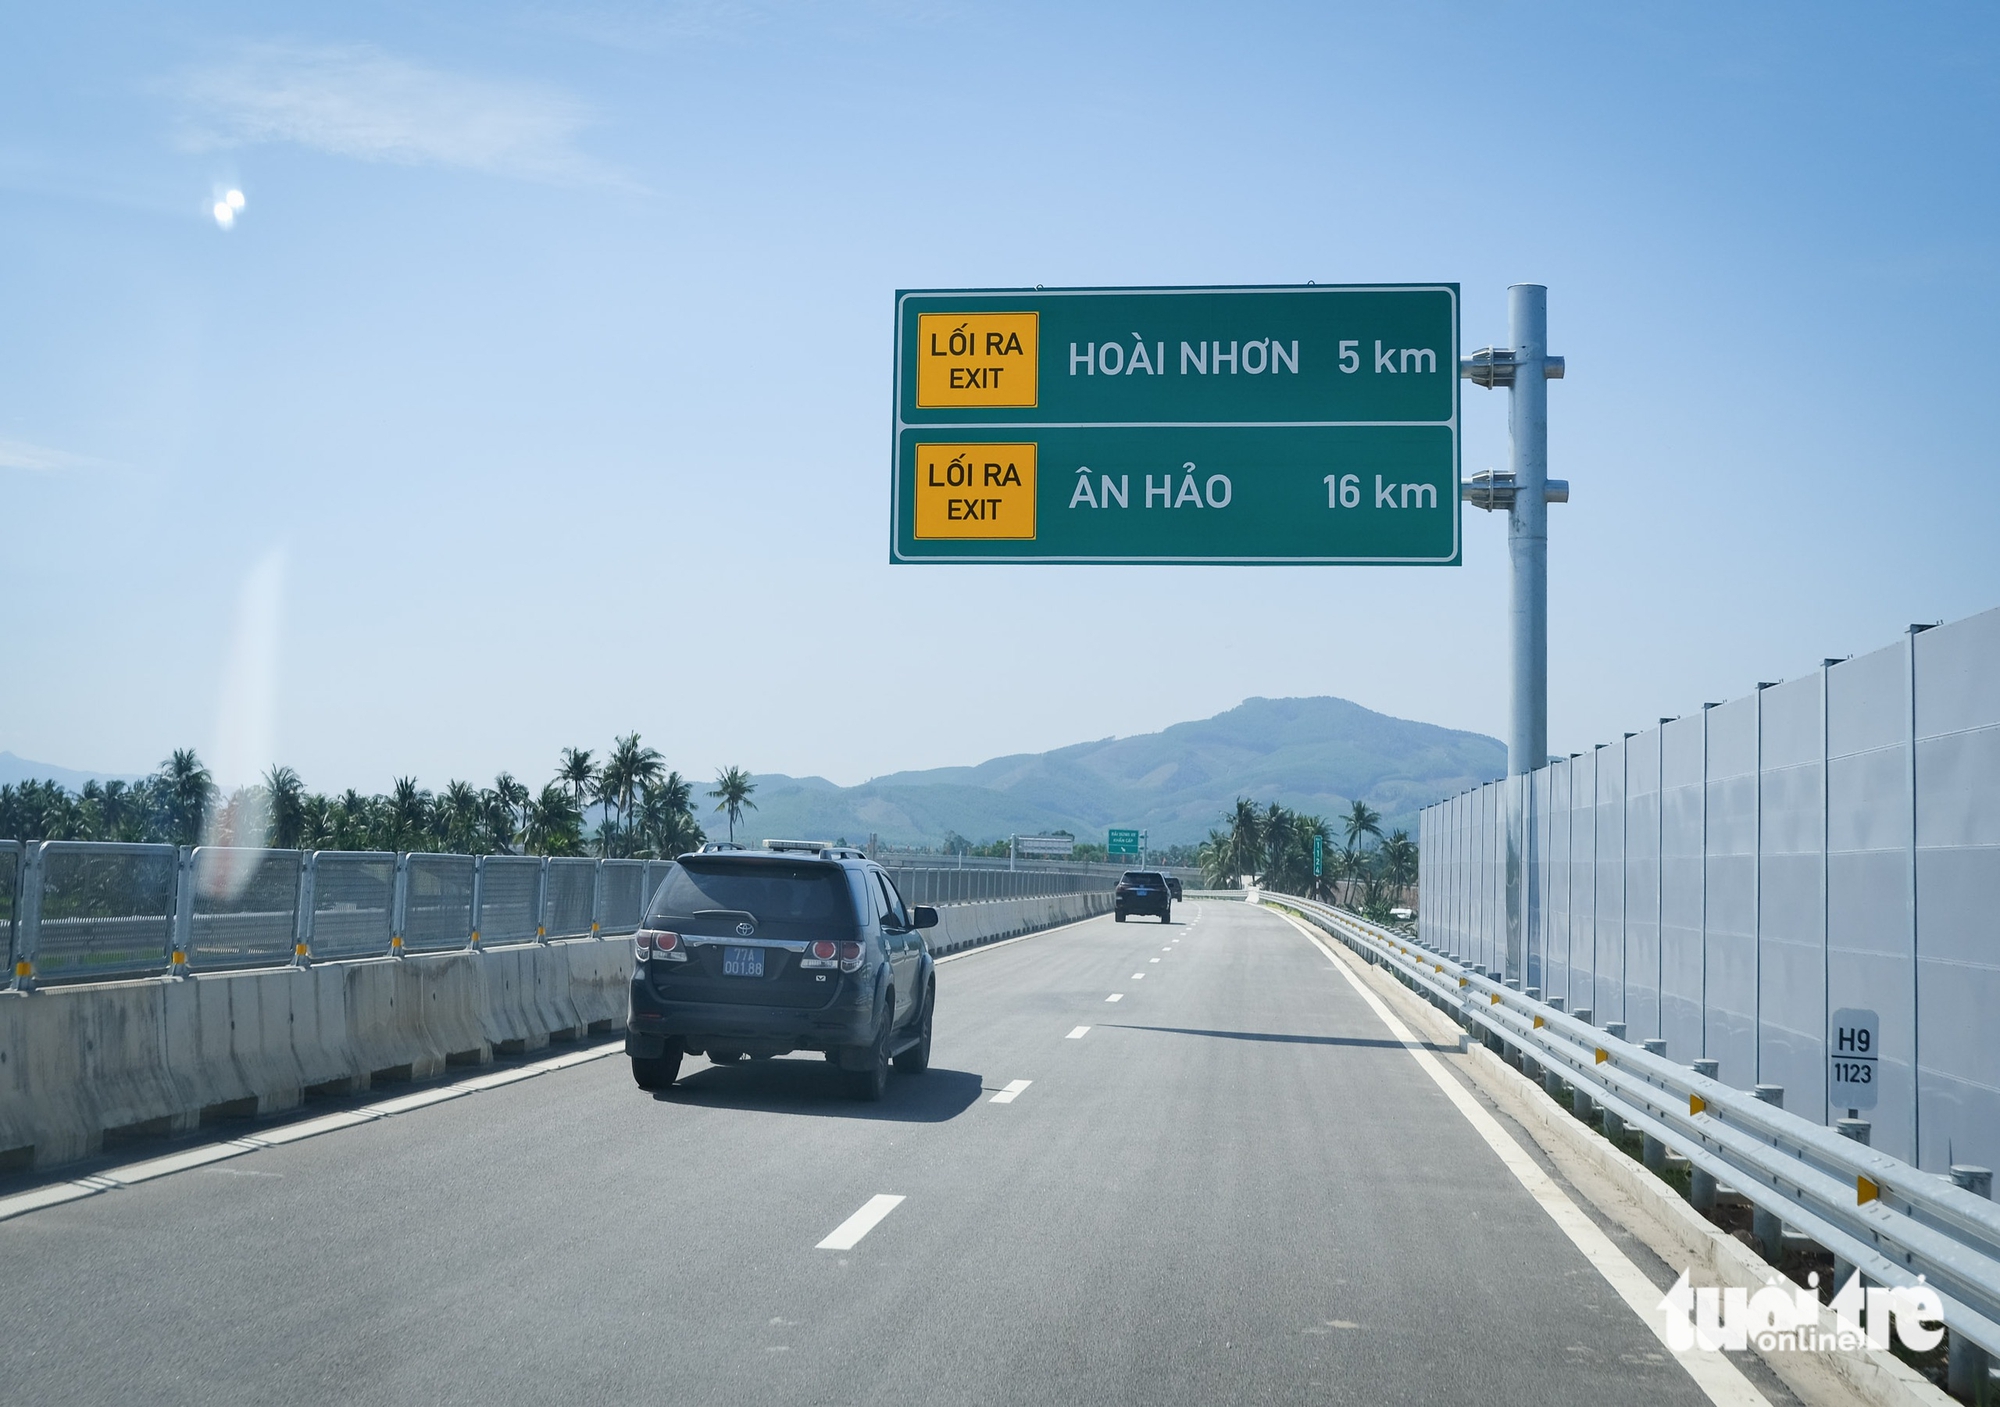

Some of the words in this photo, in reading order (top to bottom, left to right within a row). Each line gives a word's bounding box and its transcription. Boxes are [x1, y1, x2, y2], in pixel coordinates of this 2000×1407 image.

[931, 323, 975, 356] LỐI
[986, 332, 1024, 356] RA
[1069, 332, 1165, 376] HOÀI
[1180, 336, 1299, 375] NHƠN
[1338, 340, 1360, 374] 5
[1375, 340, 1437, 373] km
[949, 367, 1004, 389] EXIT
[928, 453, 973, 487] LỐI
[984, 463, 1022, 487] RA
[1068, 466, 1129, 508] ÂN
[1145, 461, 1232, 508] HẢO
[1323, 474, 1360, 508] 16
[1375, 474, 1437, 508] km
[947, 498, 1002, 520] EXIT
[734, 948, 754, 961] 77A
[725, 961, 762, 975] 001.88
[1838, 1027, 1871, 1052] H9
[1834, 1062, 1872, 1084] 1123
